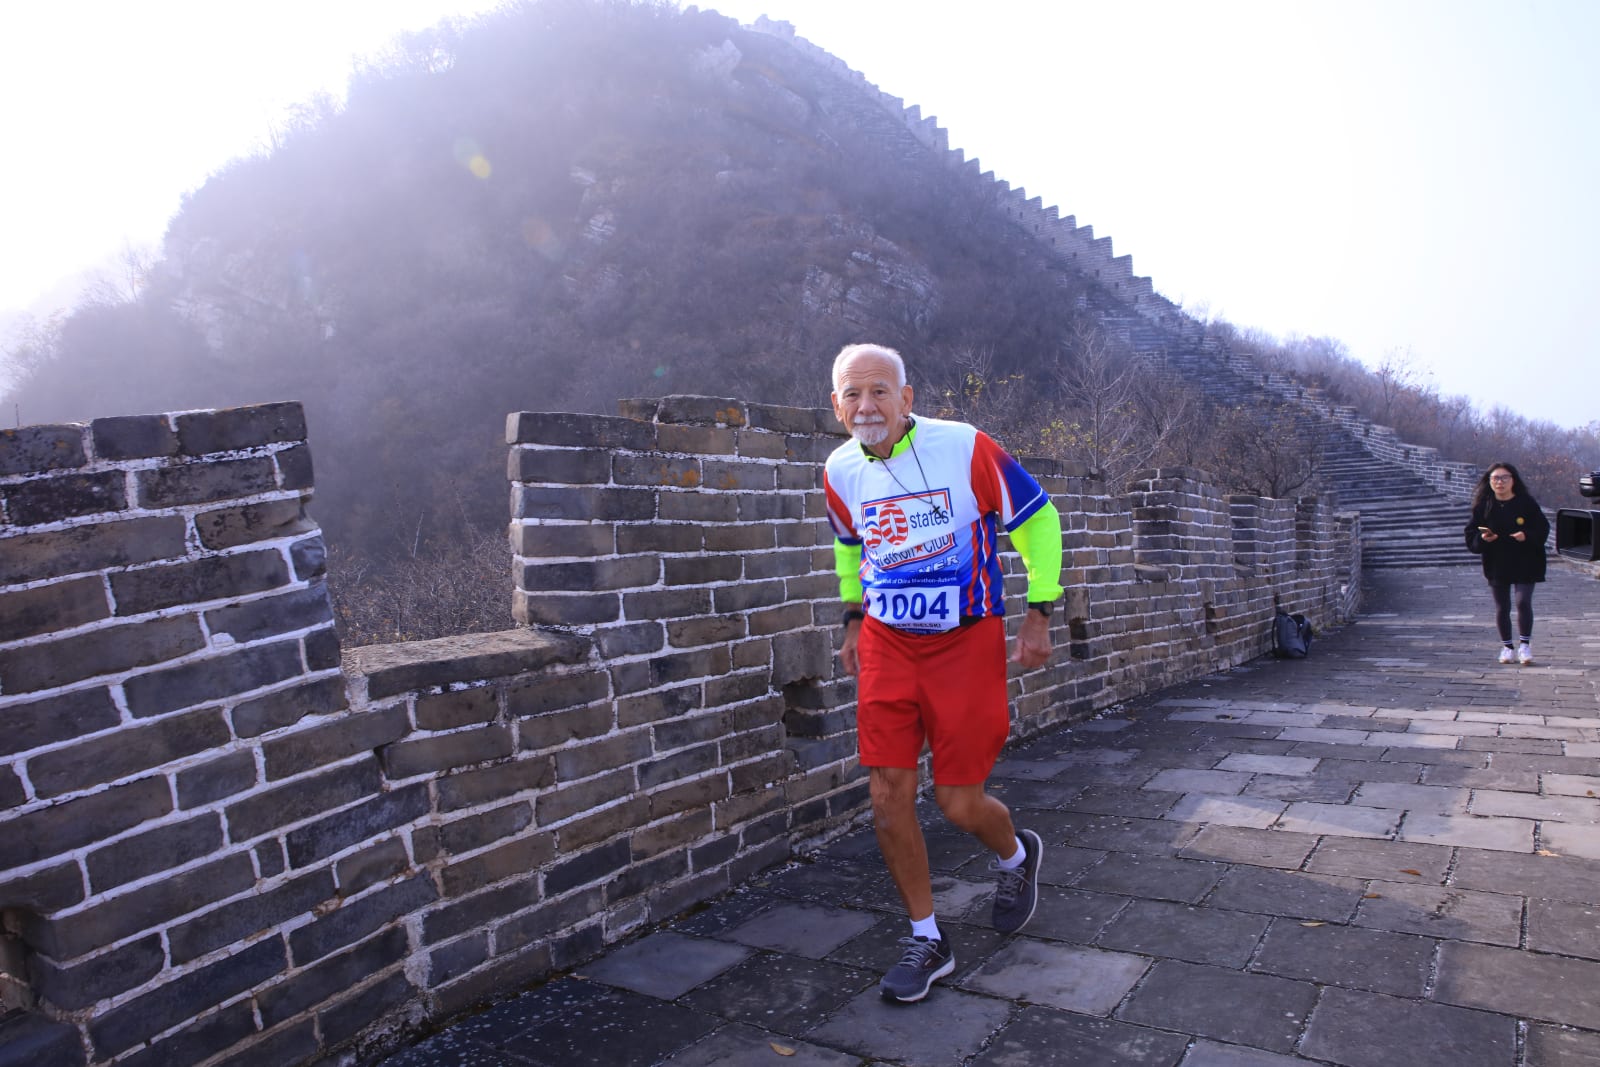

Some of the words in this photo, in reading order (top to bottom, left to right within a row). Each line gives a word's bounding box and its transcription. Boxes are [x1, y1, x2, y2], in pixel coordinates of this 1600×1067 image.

[864, 503, 908, 548] 50
[910, 509, 950, 529] states
[876, 592, 949, 620] 1004
